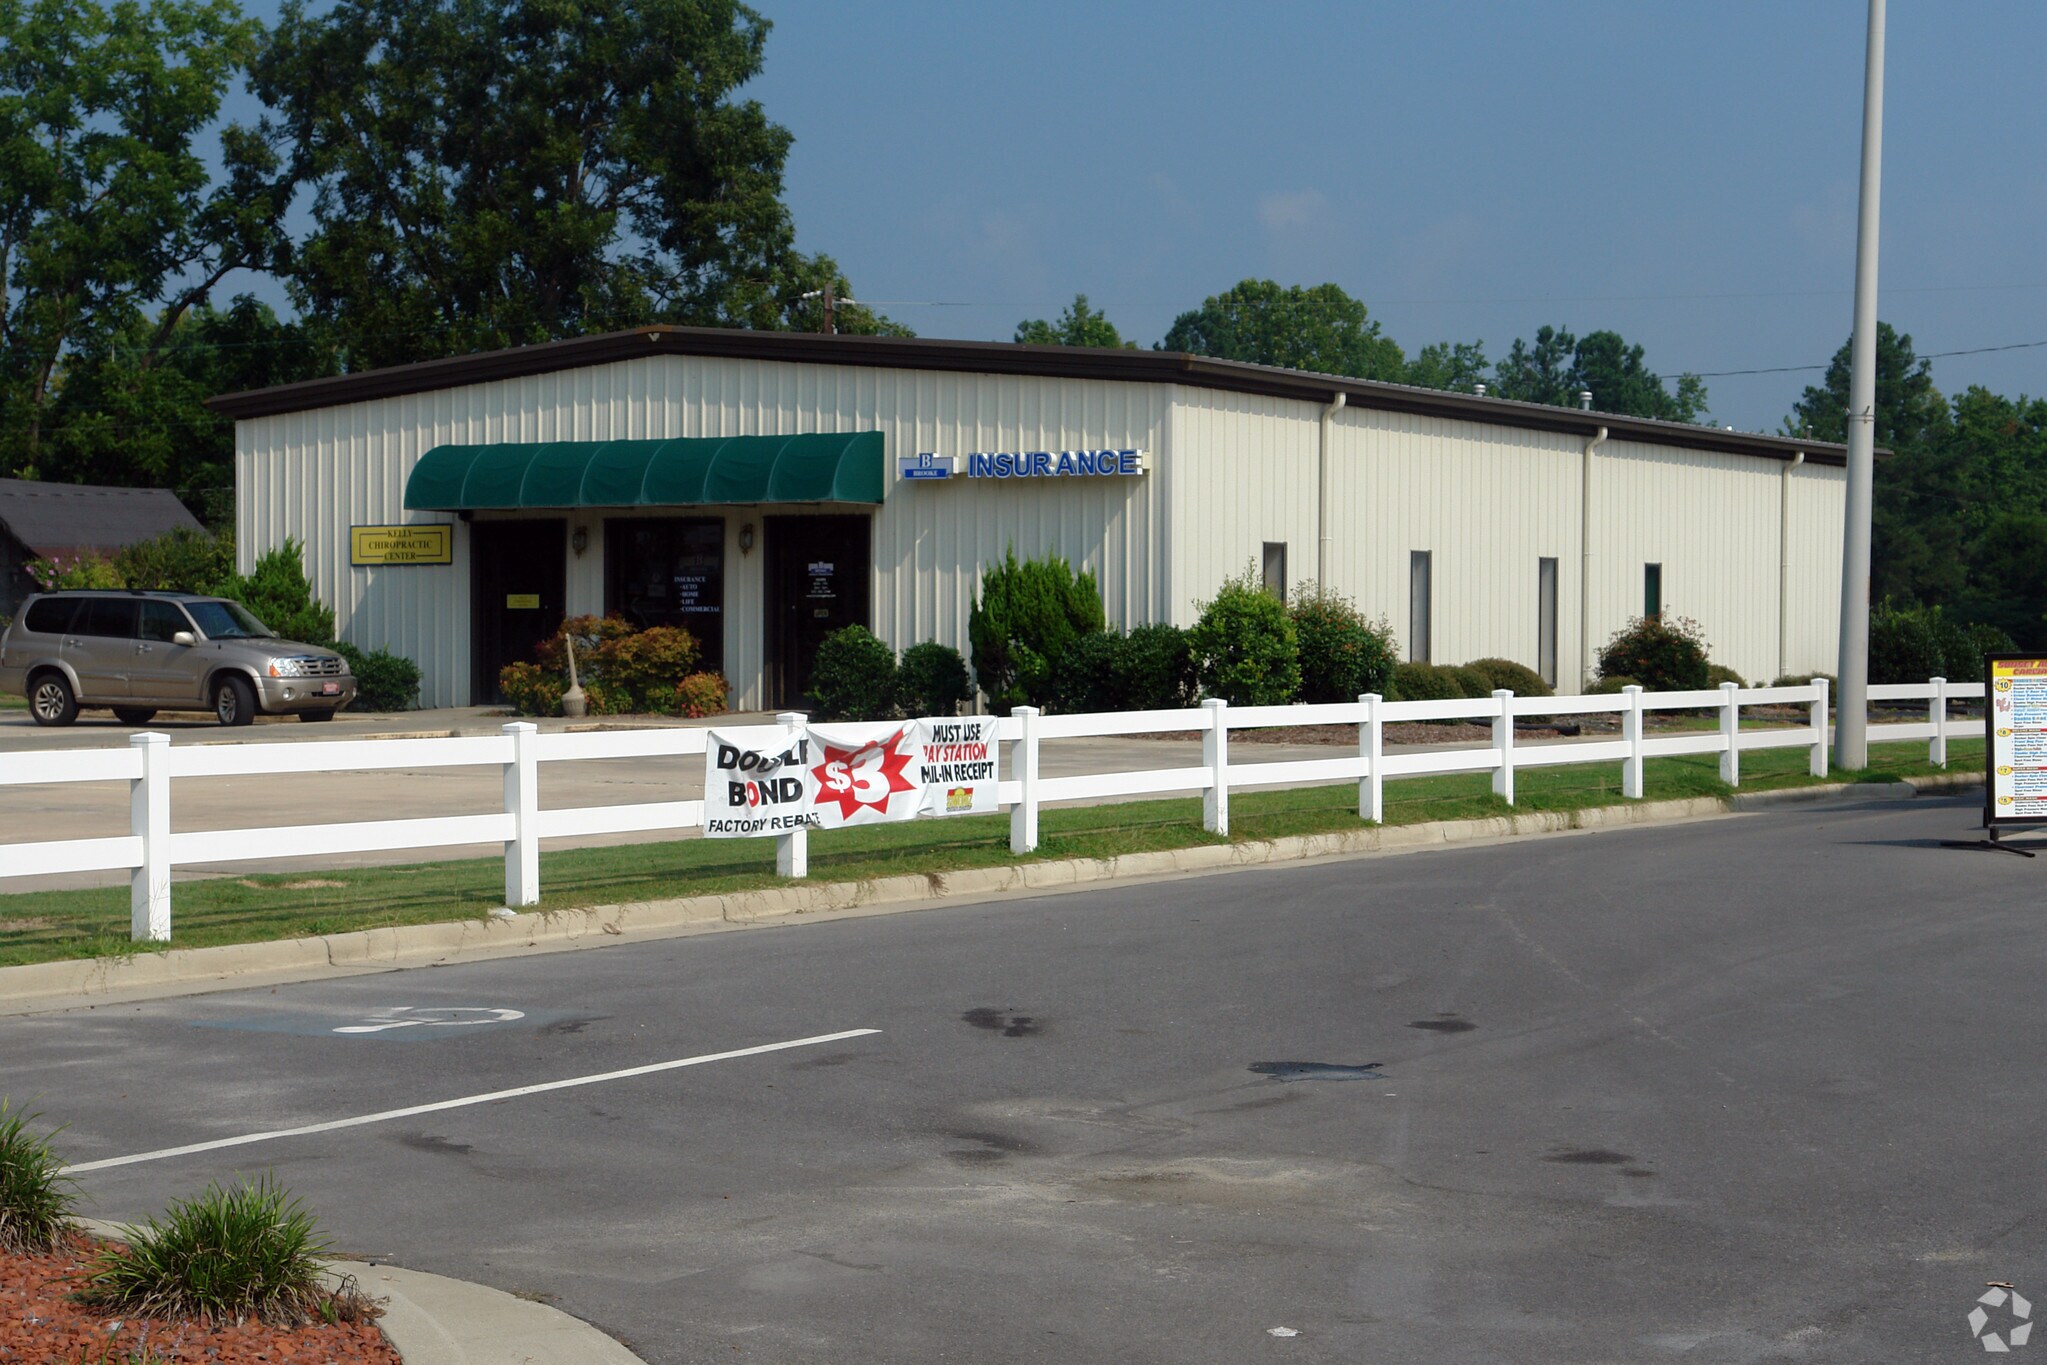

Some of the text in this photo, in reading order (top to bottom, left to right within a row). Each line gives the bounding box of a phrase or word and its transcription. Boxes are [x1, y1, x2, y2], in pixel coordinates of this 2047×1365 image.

[921, 456, 931, 467] B
[968, 450, 1137, 478] INSURANCE
[387, 530, 413, 538] KELLY
[368, 540, 432, 550] CHIROPRACTIC
[384, 552, 416, 560] CENTER
[932, 723, 981, 743] MUST USE
[943, 742, 988, 762] STATION
[824, 747, 891, 805] $3
[954, 761, 994, 781] RECEIPT
[728, 777, 803, 808] BOND
[708, 817, 767, 833] FACTORY
